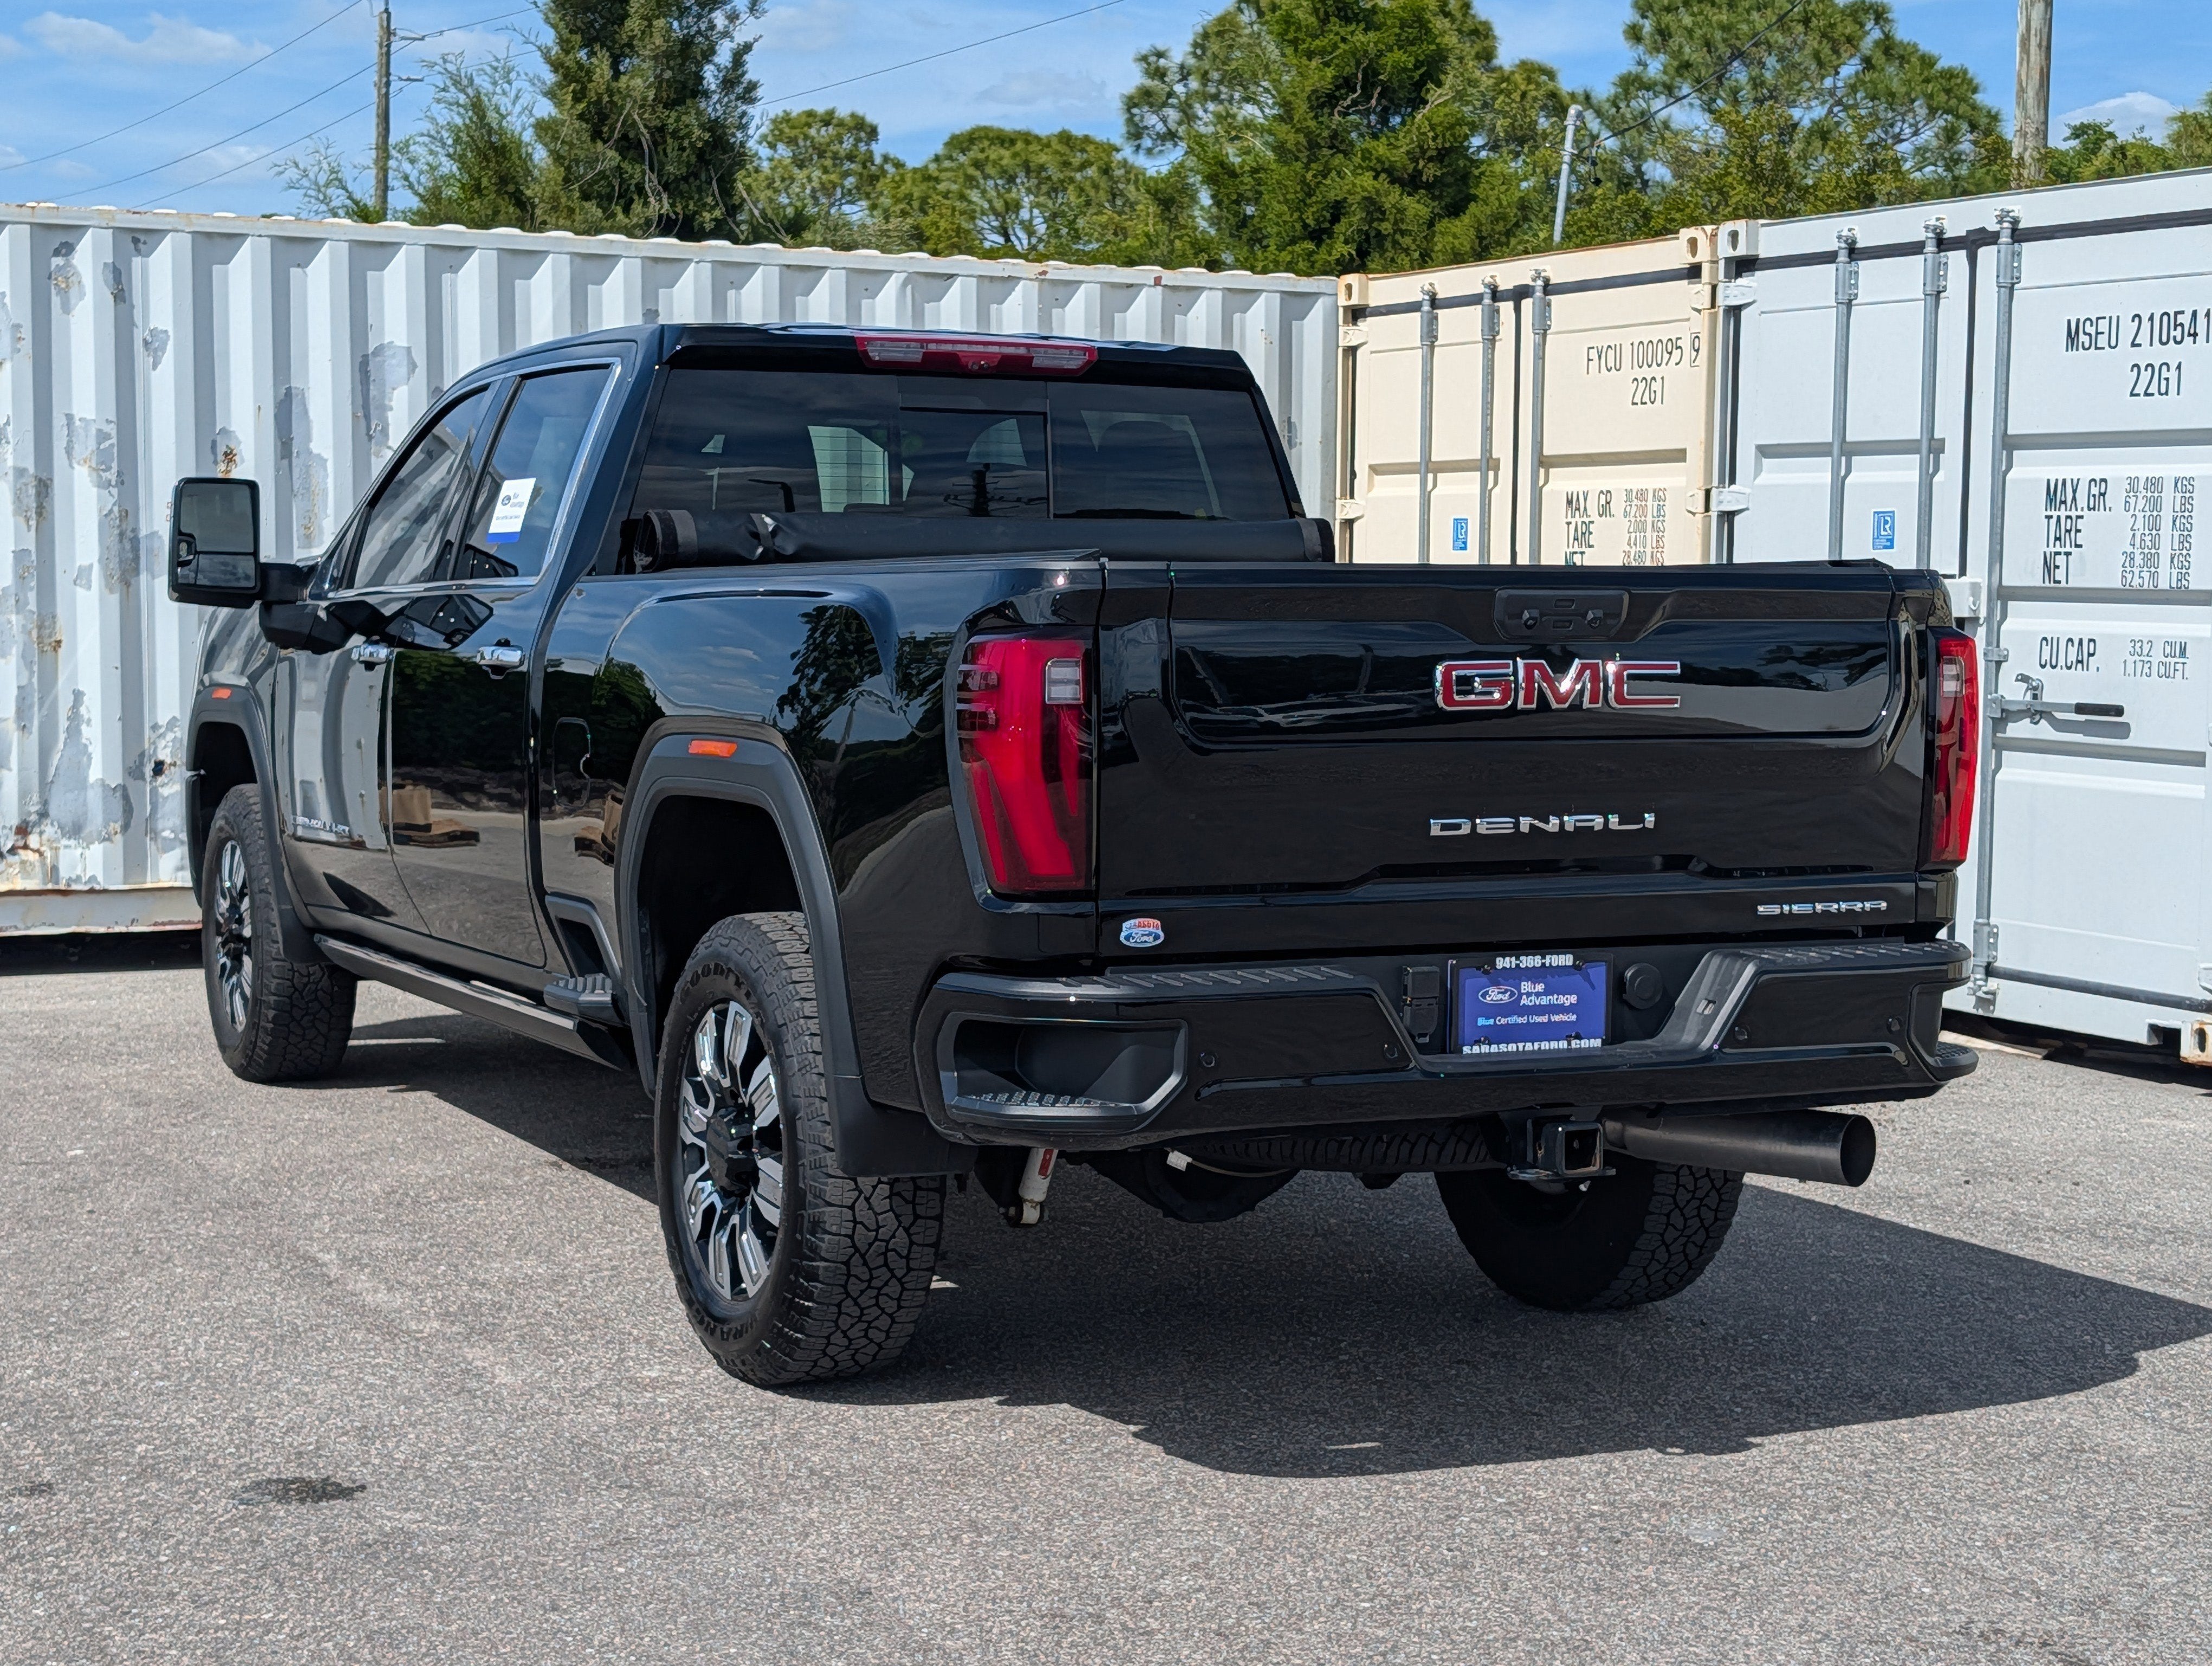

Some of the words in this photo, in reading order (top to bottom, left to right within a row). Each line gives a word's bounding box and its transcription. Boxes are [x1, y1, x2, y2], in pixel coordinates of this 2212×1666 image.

[2065, 315, 2120, 352] MSEU
[2130, 308, 2211, 348] 210541
[1586, 343, 1623, 375] FYCU
[1630, 336, 1683, 370] 100095
[1692, 335, 1701, 364] 9
[2129, 361, 2182, 397] 22G1
[1631, 376, 1664, 406] 22G1
[2125, 476, 2164, 494] 30.480
[2174, 476, 2195, 494] KGS
[1565, 490, 1591, 519] MAX.
[1597, 489, 1615, 518] GR.
[1624, 488, 1649, 503] 30.480
[1652, 488, 1667, 503] KGS
[1651, 503, 1666, 518] LBS
[2124, 495, 2163, 513] 67.200
[2172, 495, 2194, 513] LBS
[1565, 521, 1594, 549] TARE
[1628, 519, 1648, 534] 2.000
[1651, 519, 1666, 534] KGS
[2044, 515, 2084, 548] TARE
[2130, 514, 2162, 532] 2.100
[2171, 514, 2193, 533] KGS
[1626, 535, 1647, 549] 4.410
[1651, 535, 1665, 549] LBS
[2129, 533, 2160, 550] 4.630
[2170, 534, 2192, 552] LBS
[2042, 551, 2072, 585] NET
[2121, 550, 2160, 569] 28.380
[2170, 552, 2191, 571] KGS
[2120, 569, 2159, 588] 62.570
[2169, 571, 2190, 589] LBS
[2129, 639, 2153, 657] 33.2
[2123, 659, 2152, 678] 1.173
[1433, 658, 1681, 710] GMC
[1430, 813, 1655, 836] DENALI
[1757, 900, 1887, 915] SIERRA
[1129, 931, 1155, 943] Ford
[1495, 954, 1574, 969] 941-366-FORD
[1486, 989, 1511, 1001] Ford
[1521, 981, 1545, 993] Blue
[1520, 993, 1578, 1007] Advantage
[1496, 1015, 1527, 1025] Certified
[1529, 1014, 1549, 1023] Used
[1550, 1012, 1577, 1022] Vehicle
